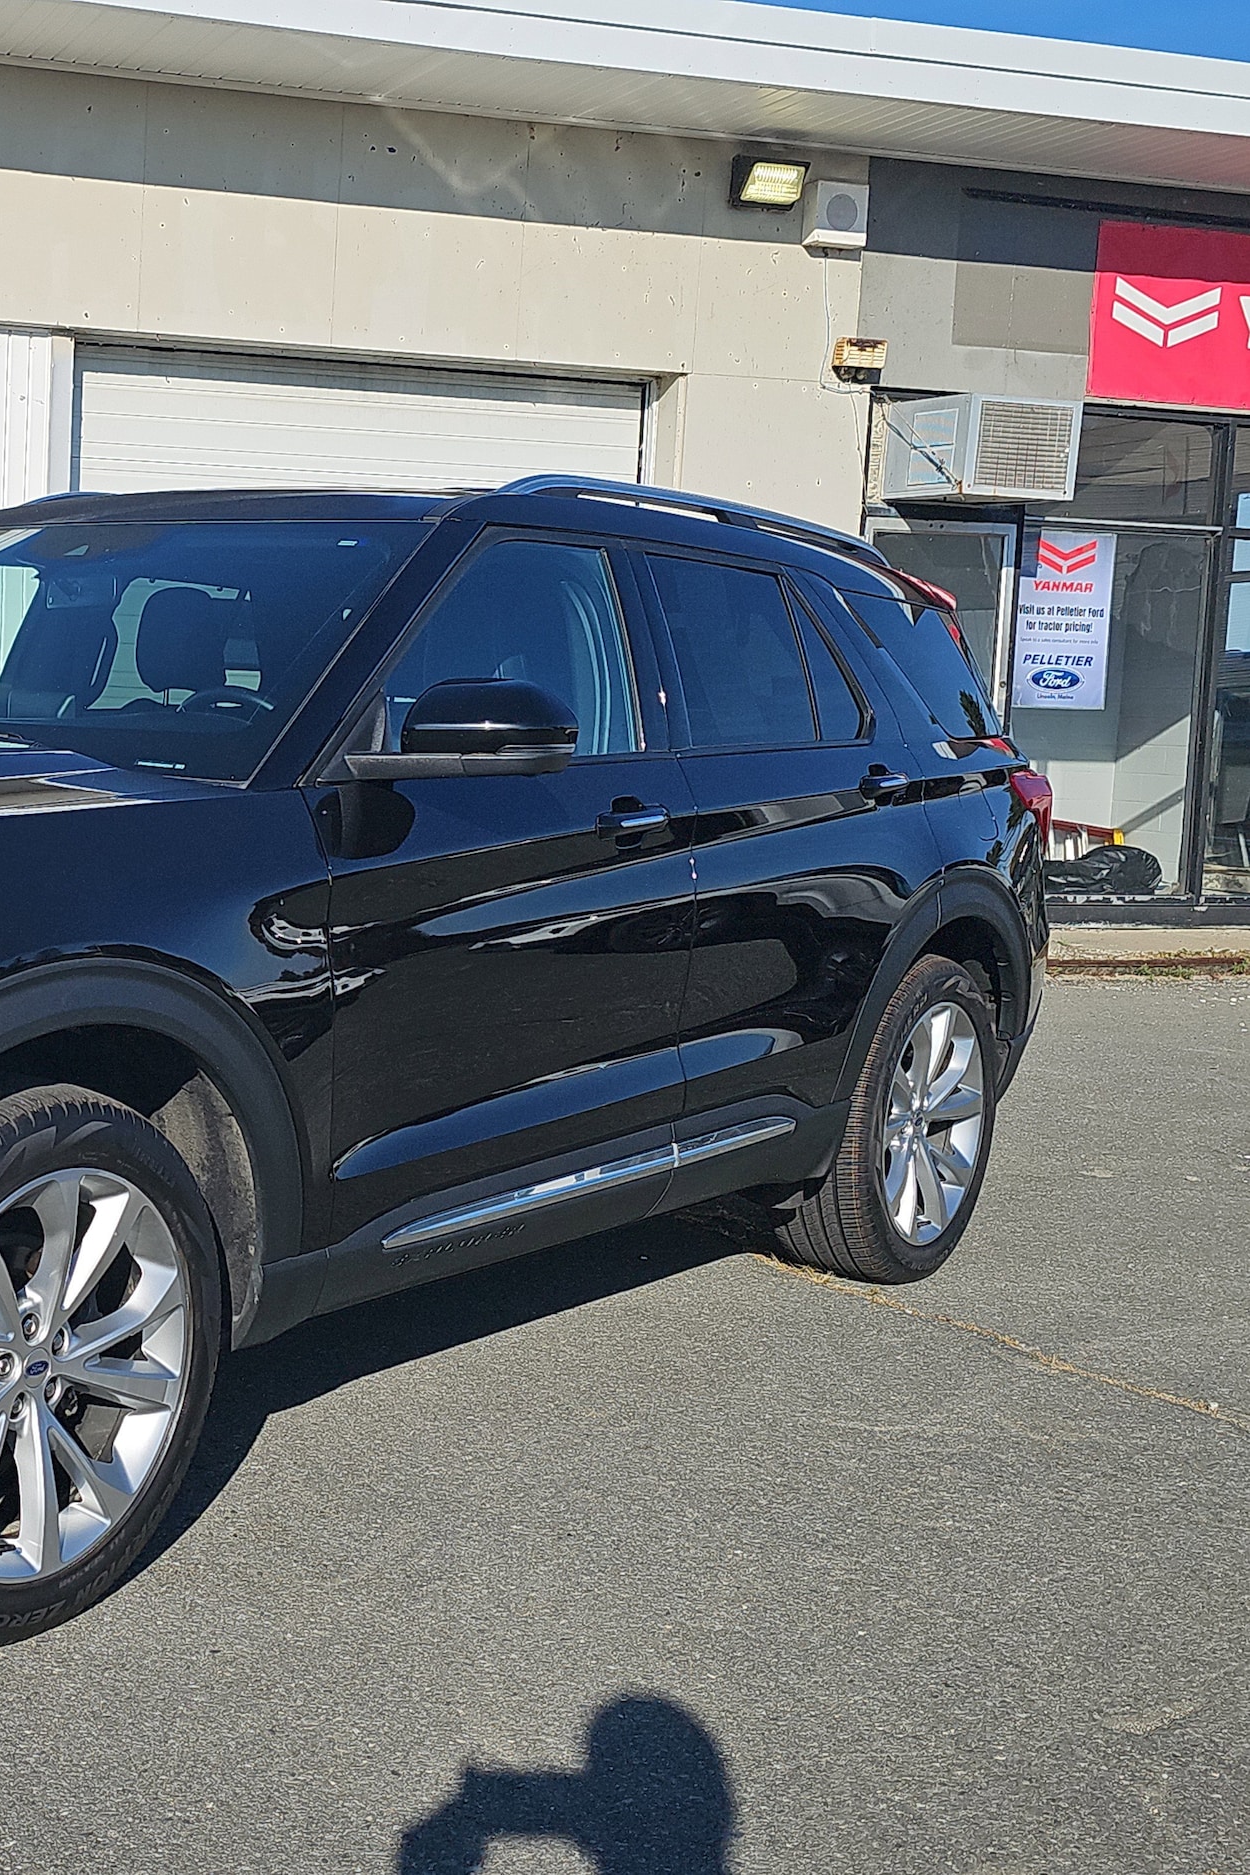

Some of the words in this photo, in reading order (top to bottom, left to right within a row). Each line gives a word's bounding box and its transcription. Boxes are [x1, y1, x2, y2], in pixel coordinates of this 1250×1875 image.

[1033, 580, 1094, 593] YANMAR
[1019, 603, 1035, 615] Visit
[1036, 606, 1046, 616] us
[1047, 606, 1055, 616] at
[1056, 606, 1087, 618] Pelletier
[1088, 607, 1105, 618] Ford
[1025, 620, 1037, 630] for
[1038, 620, 1064, 632] tractor
[1064, 621, 1093, 633] pricing!
[1022, 653, 1094, 667] PELLETIER
[1038, 672, 1072, 688] Ford
